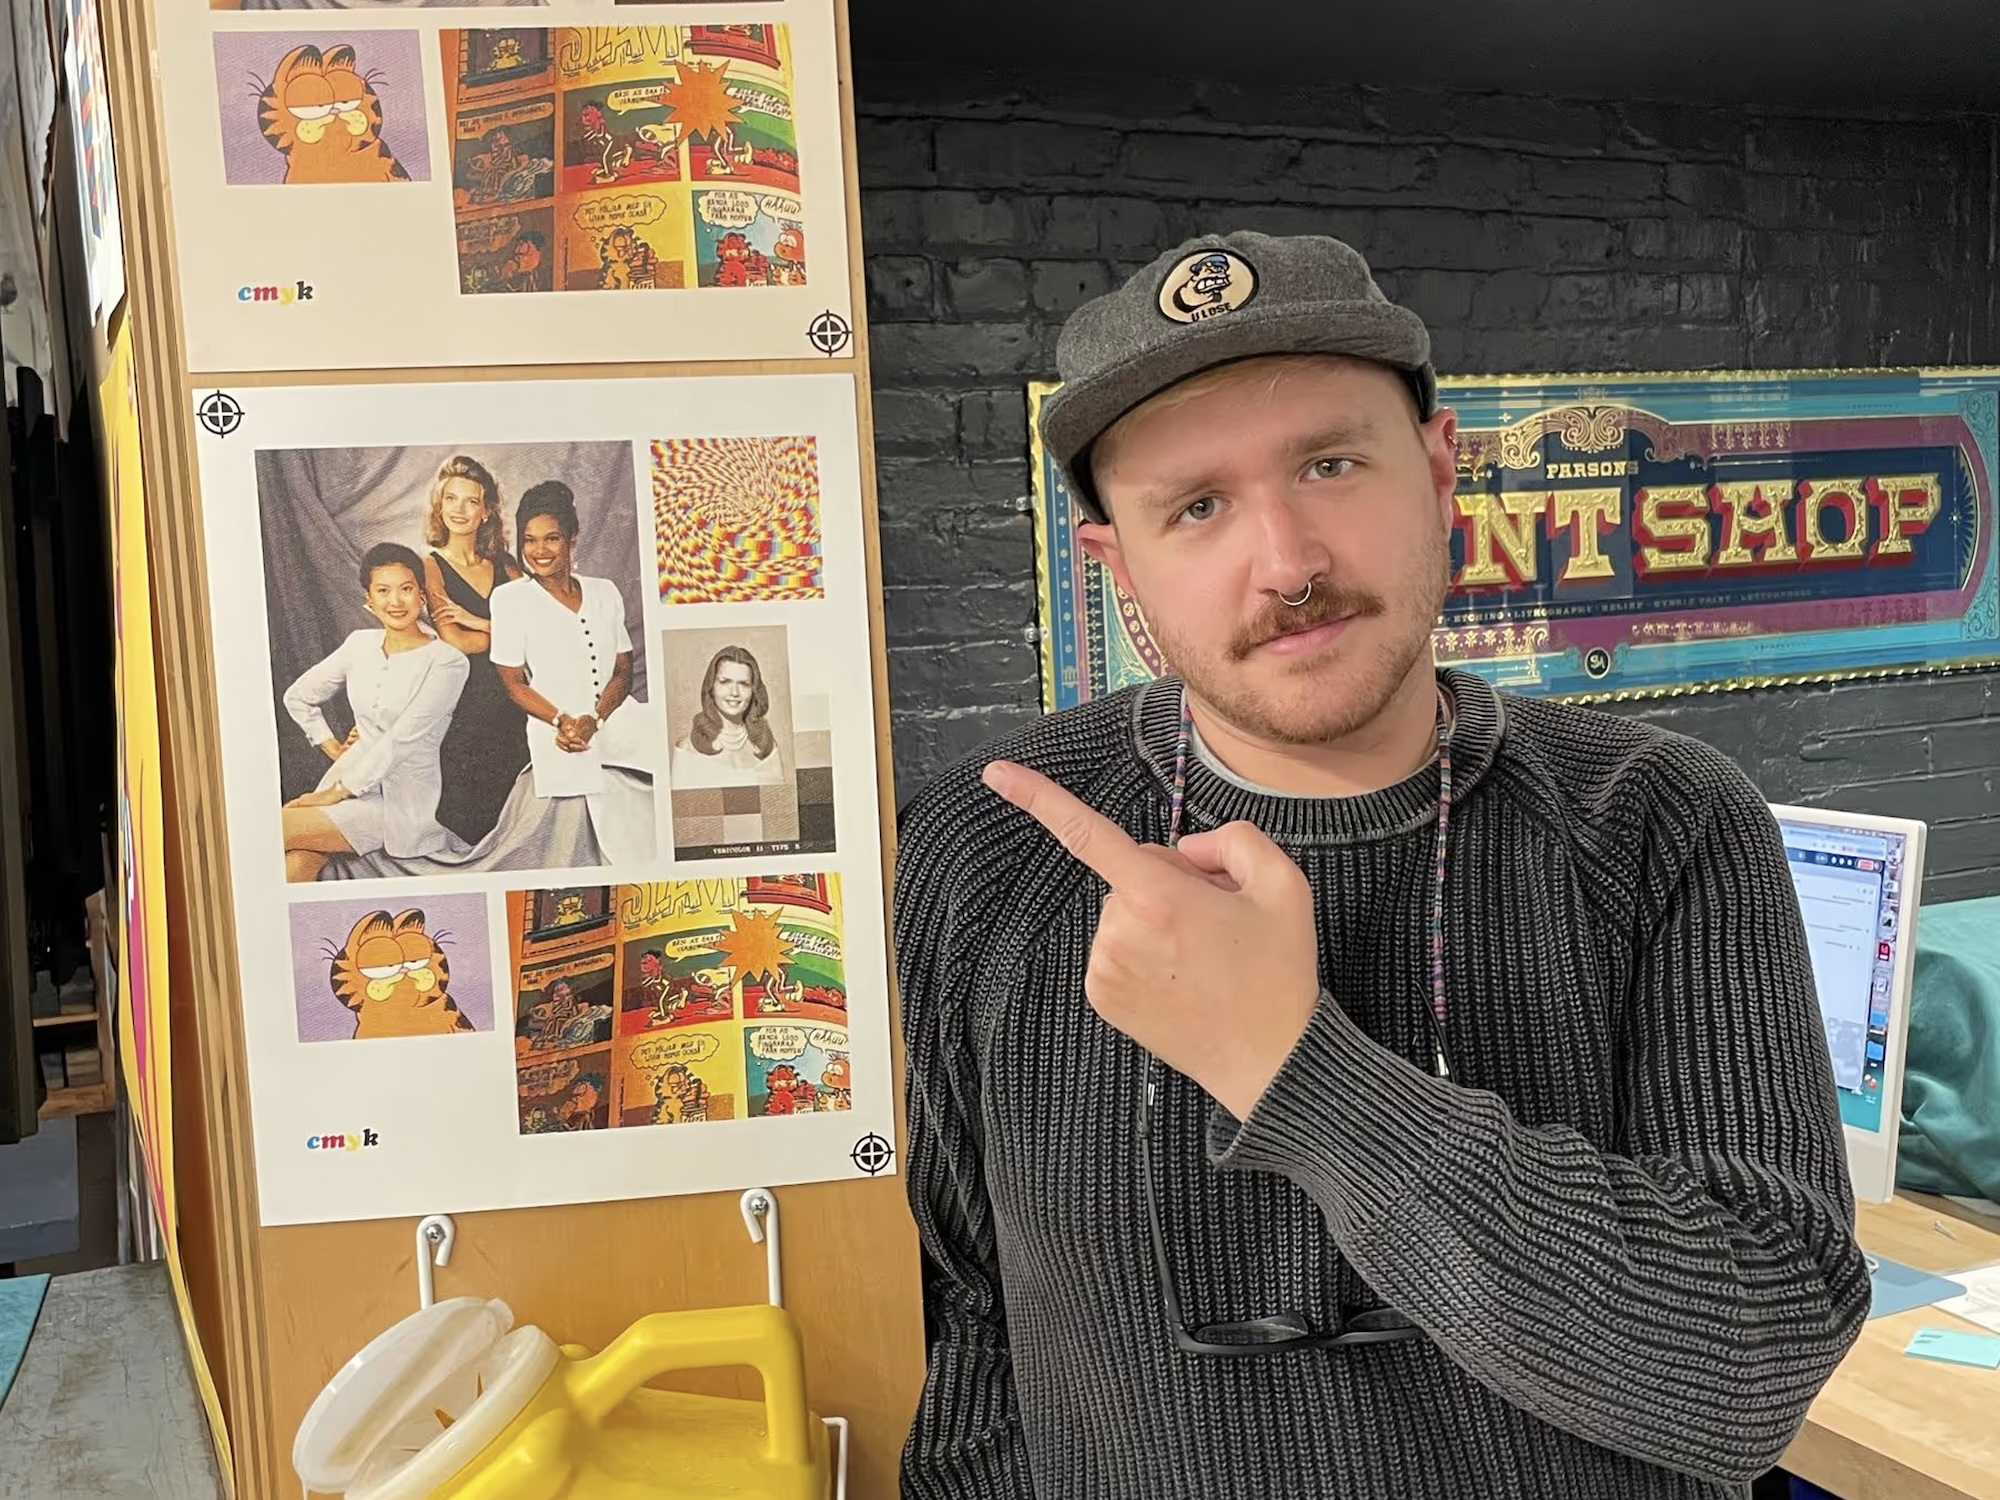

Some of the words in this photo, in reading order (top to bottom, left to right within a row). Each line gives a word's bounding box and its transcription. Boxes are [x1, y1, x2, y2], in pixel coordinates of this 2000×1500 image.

[238, 280, 314, 305] cmyk
[1191, 312, 1200, 322] U
[1546, 460, 1639, 480] PARSONS
[1636, 473, 1942, 578] SHOP
[306, 1127, 379, 1152] cmyk
